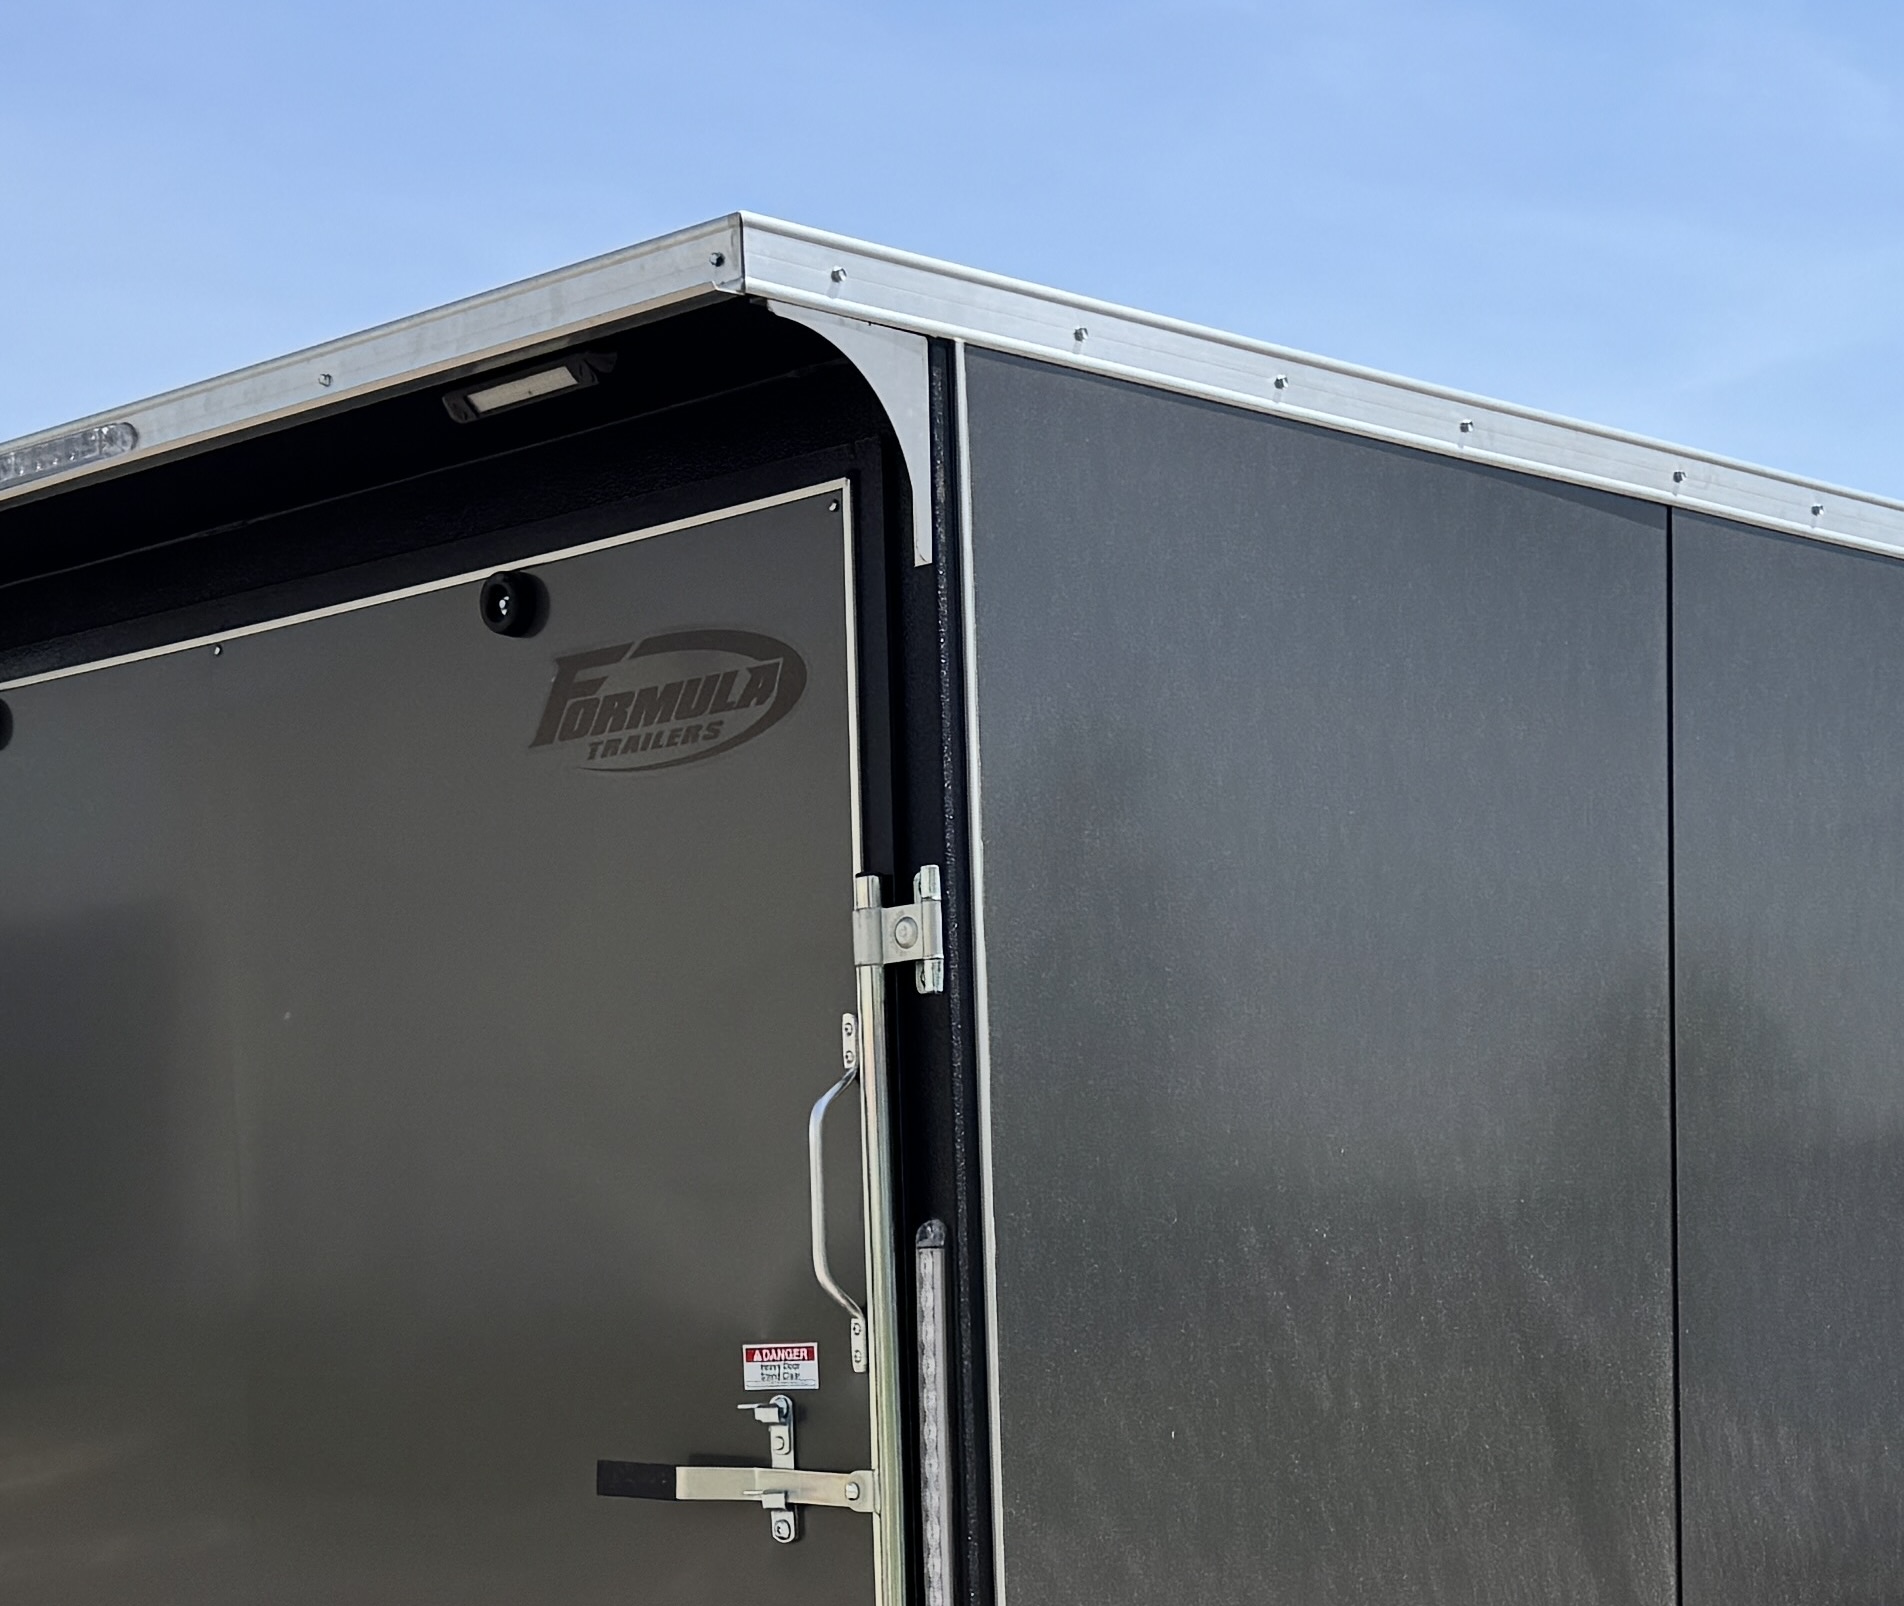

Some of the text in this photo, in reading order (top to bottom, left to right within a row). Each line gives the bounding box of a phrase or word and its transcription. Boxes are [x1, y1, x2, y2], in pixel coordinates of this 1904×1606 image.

[528, 641, 781, 748] FORMULA
[587, 719, 724, 761] TRAILERS
[762, 1348, 808, 1361] DANGER
